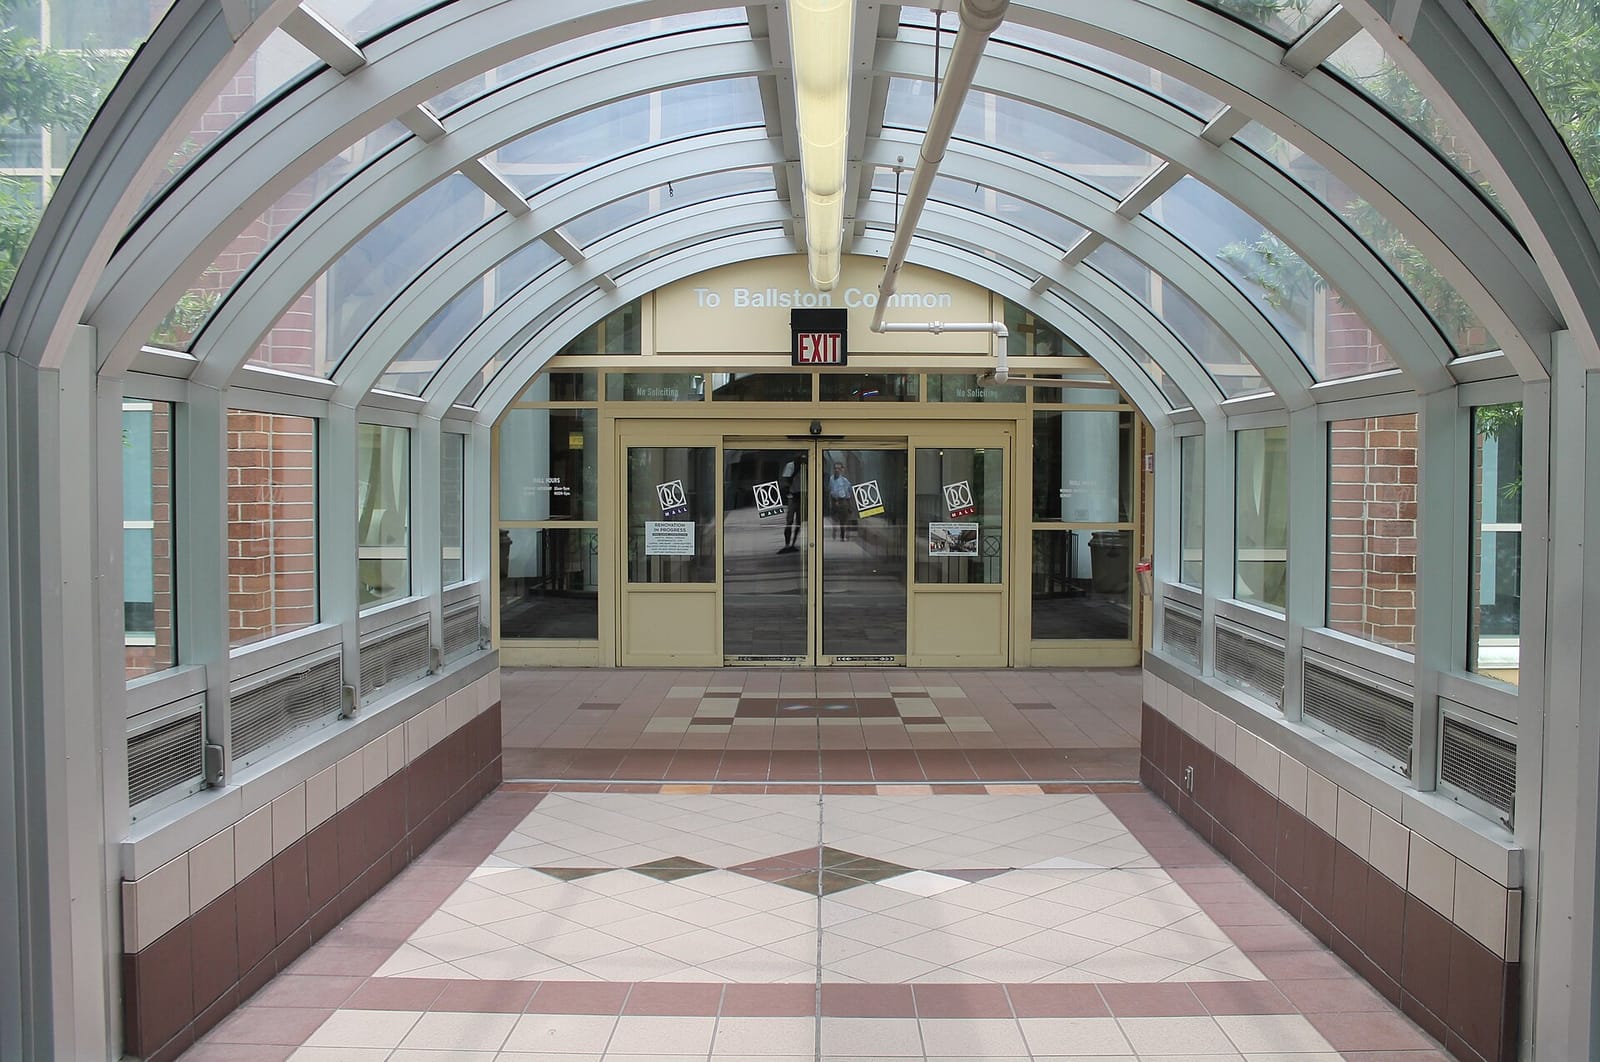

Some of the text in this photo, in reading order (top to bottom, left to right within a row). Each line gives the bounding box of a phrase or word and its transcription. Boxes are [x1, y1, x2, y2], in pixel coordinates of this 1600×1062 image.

[694, 288, 952, 308] To Ballston Common
[799, 334, 841, 363] EXIT
[637, 387, 679, 398] No Soliciting
[956, 388, 966, 397] No
[664, 507, 688, 517] MALL
[760, 508, 784, 517] MALL
[951, 508, 975, 518] MALL
